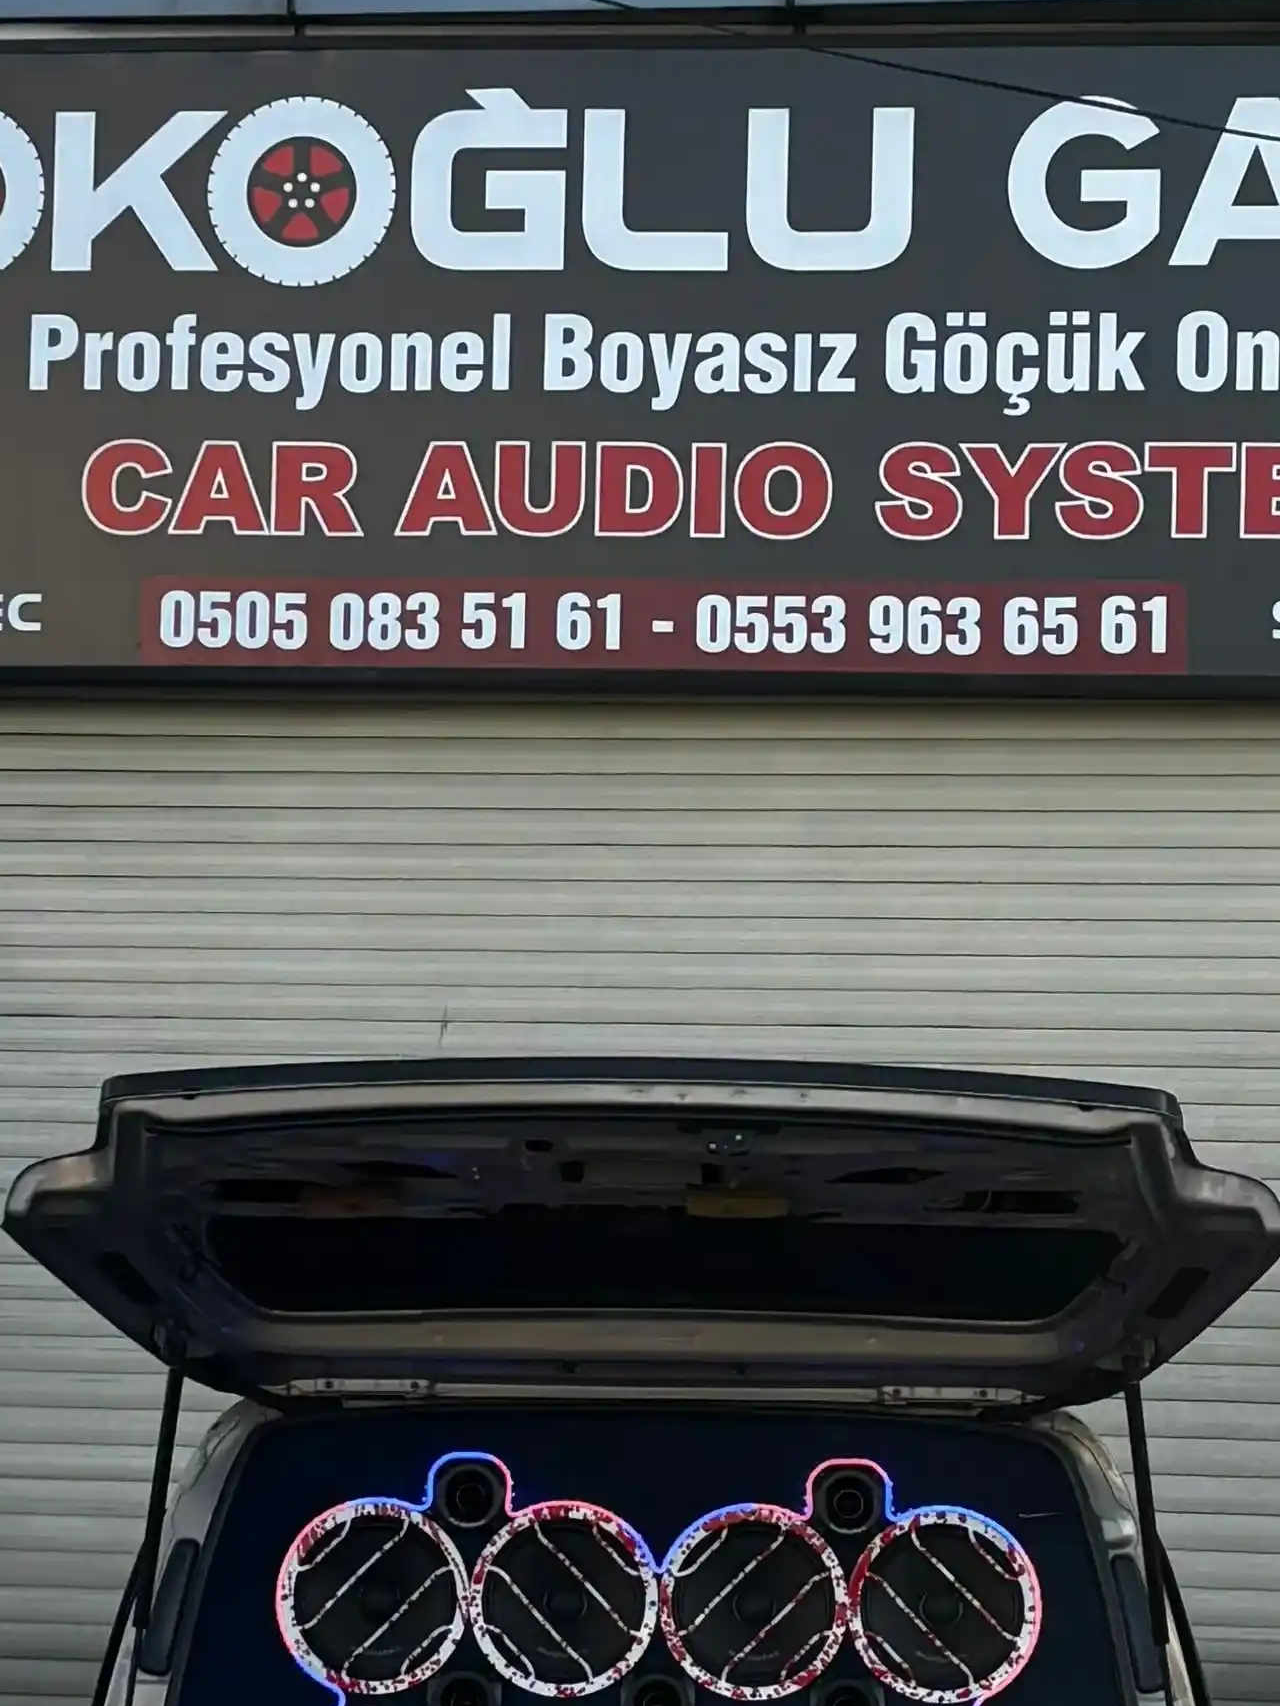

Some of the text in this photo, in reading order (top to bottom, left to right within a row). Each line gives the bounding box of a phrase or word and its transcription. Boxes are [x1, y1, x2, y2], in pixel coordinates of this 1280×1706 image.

[29, 313, 511, 410] Profesyonel
[543, 313, 856, 411] Boyasız
[885, 310, 1146, 416] Göçük
[81, 439, 364, 537] CAR
[394, 440, 833, 540] AUDIO
[159, 590, 308, 651] 0505
[328, 591, 440, 651] 083
[461, 591, 526, 650] 51
[556, 591, 622, 651] 61
[695, 595, 846, 654] 0553
[868, 595, 981, 656] 963
[1004, 596, 1078, 656] 65
[1100, 595, 1168, 655] 61
